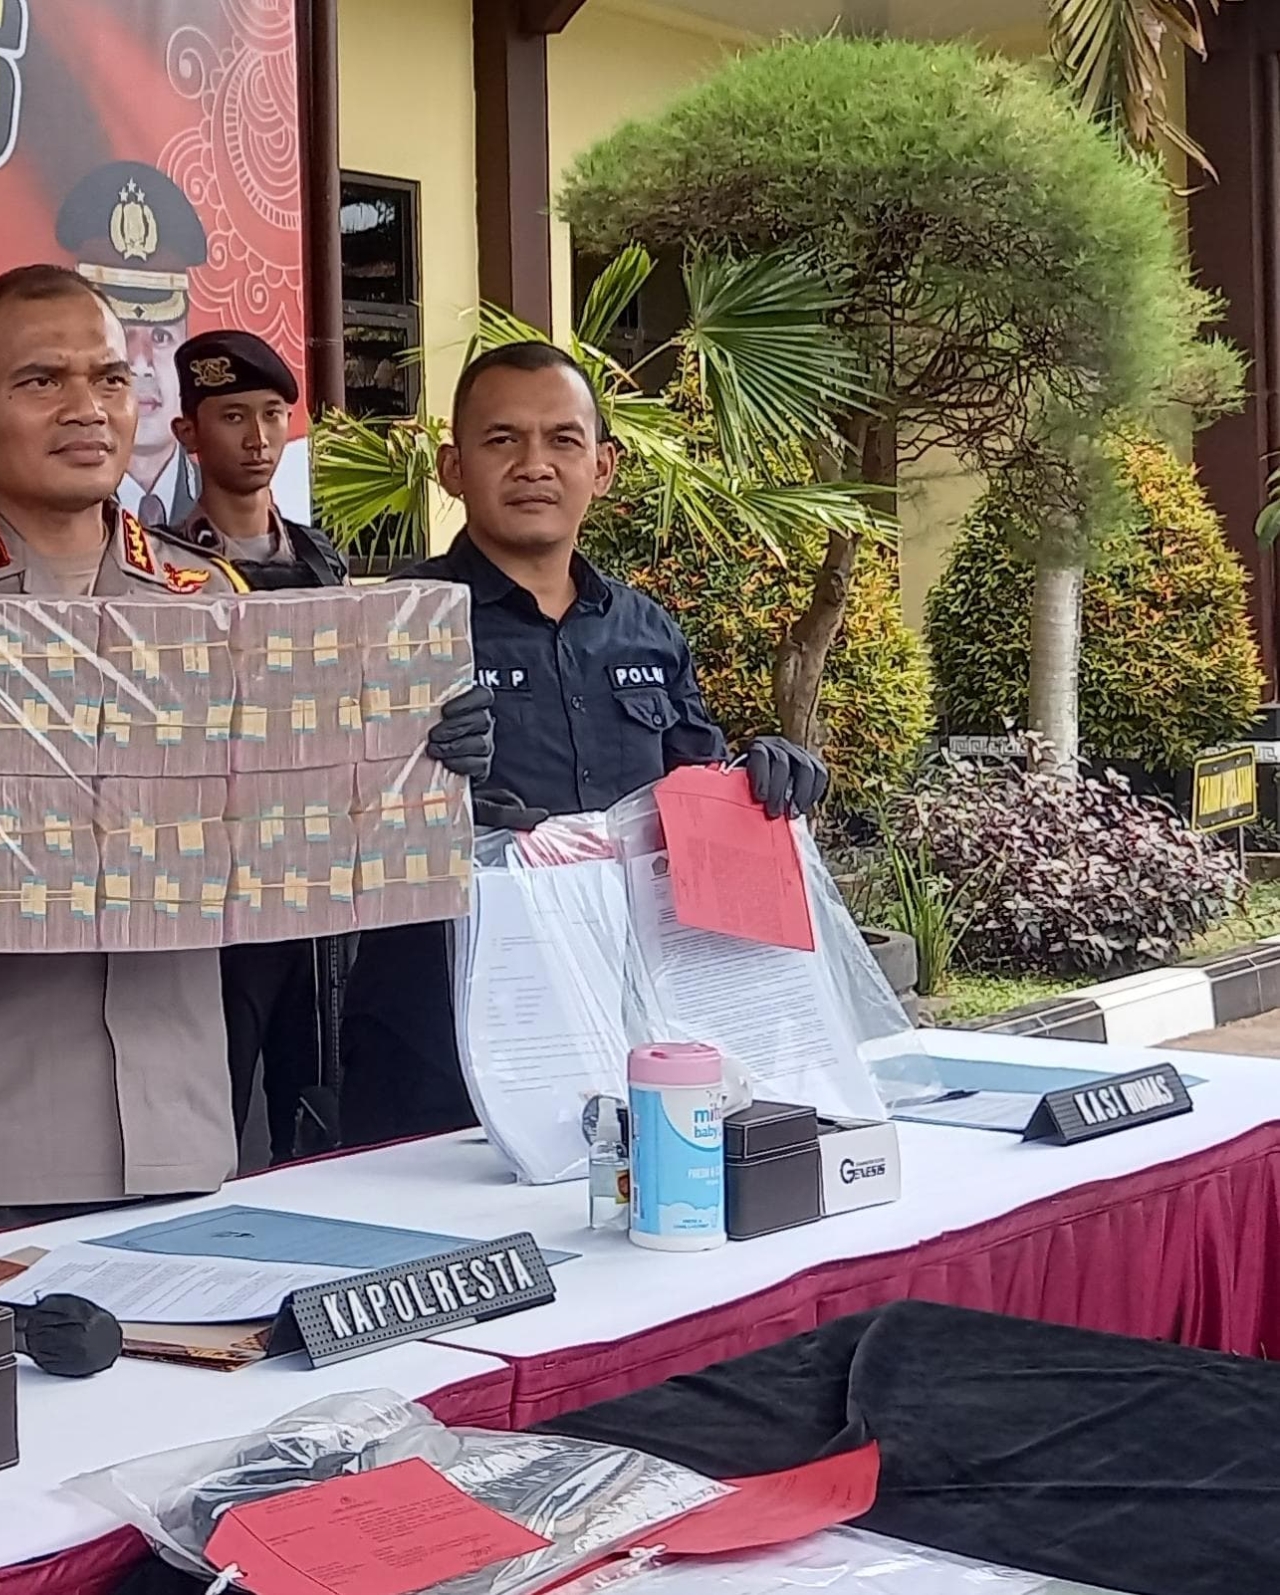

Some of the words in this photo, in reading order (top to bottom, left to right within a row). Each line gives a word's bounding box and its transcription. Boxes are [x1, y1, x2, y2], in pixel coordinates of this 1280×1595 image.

[512, 669, 524, 687] P
[1073, 1085, 1128, 1125] KASI
[322, 1248, 535, 1340] KAPOLRESTA
